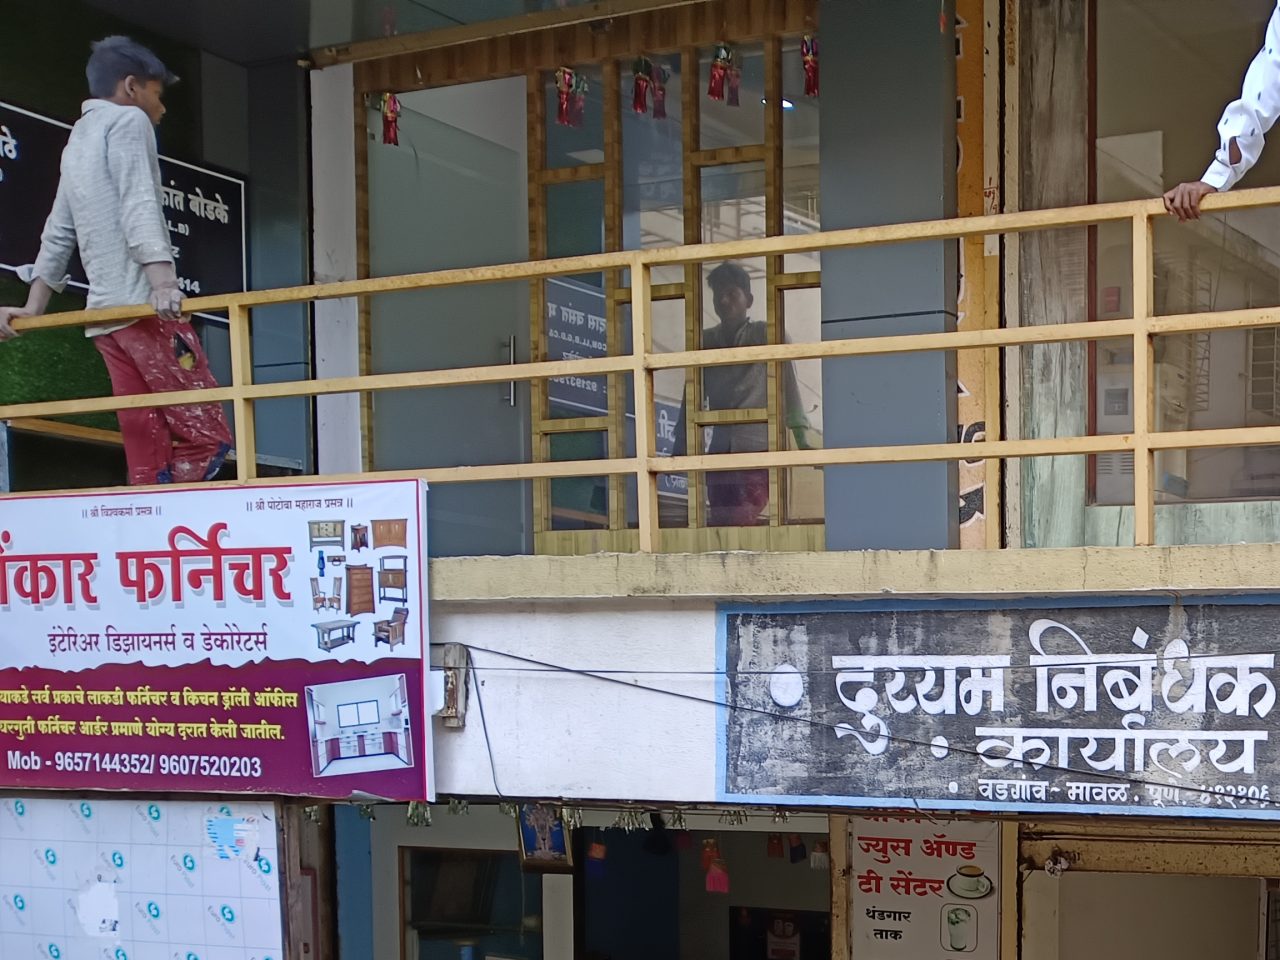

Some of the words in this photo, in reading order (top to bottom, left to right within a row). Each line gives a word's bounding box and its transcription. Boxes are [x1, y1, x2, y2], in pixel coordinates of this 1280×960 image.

[115, 522, 292, 603] फर्निचर
[48, 625, 100, 653] इंटेरिअर
[105, 624, 176, 654] डिझायनर्स
[182, 633, 195, 650] व
[200, 623, 268, 652] डेकोरेटर्स
[1029, 617, 1276, 716] निबंधक
[31, 685, 50, 704] सर्व
[87, 686, 123, 705] लाकडी
[126, 685, 168, 706] फर्निचर
[170, 691, 180, 705] व
[183, 687, 219, 706] किचन
[38, 715, 76, 734] फर्निचर
[111, 717, 143, 736] प्रमाणे
[146, 717, 175, 737] योग्य
[178, 721, 208, 740] दरात
[210, 718, 238, 738] केली
[975, 712, 1268, 776] कार्यालय
[7, 750, 41, 770] Mob
[160, 754, 262, 777] 9607520203
[858, 836, 912, 863] ज्युस
[858, 869, 883, 893] टी
[889, 870, 944, 897] सेंटर
[866, 905, 911, 923] थंडगार
[873, 928, 902, 941] ताक
